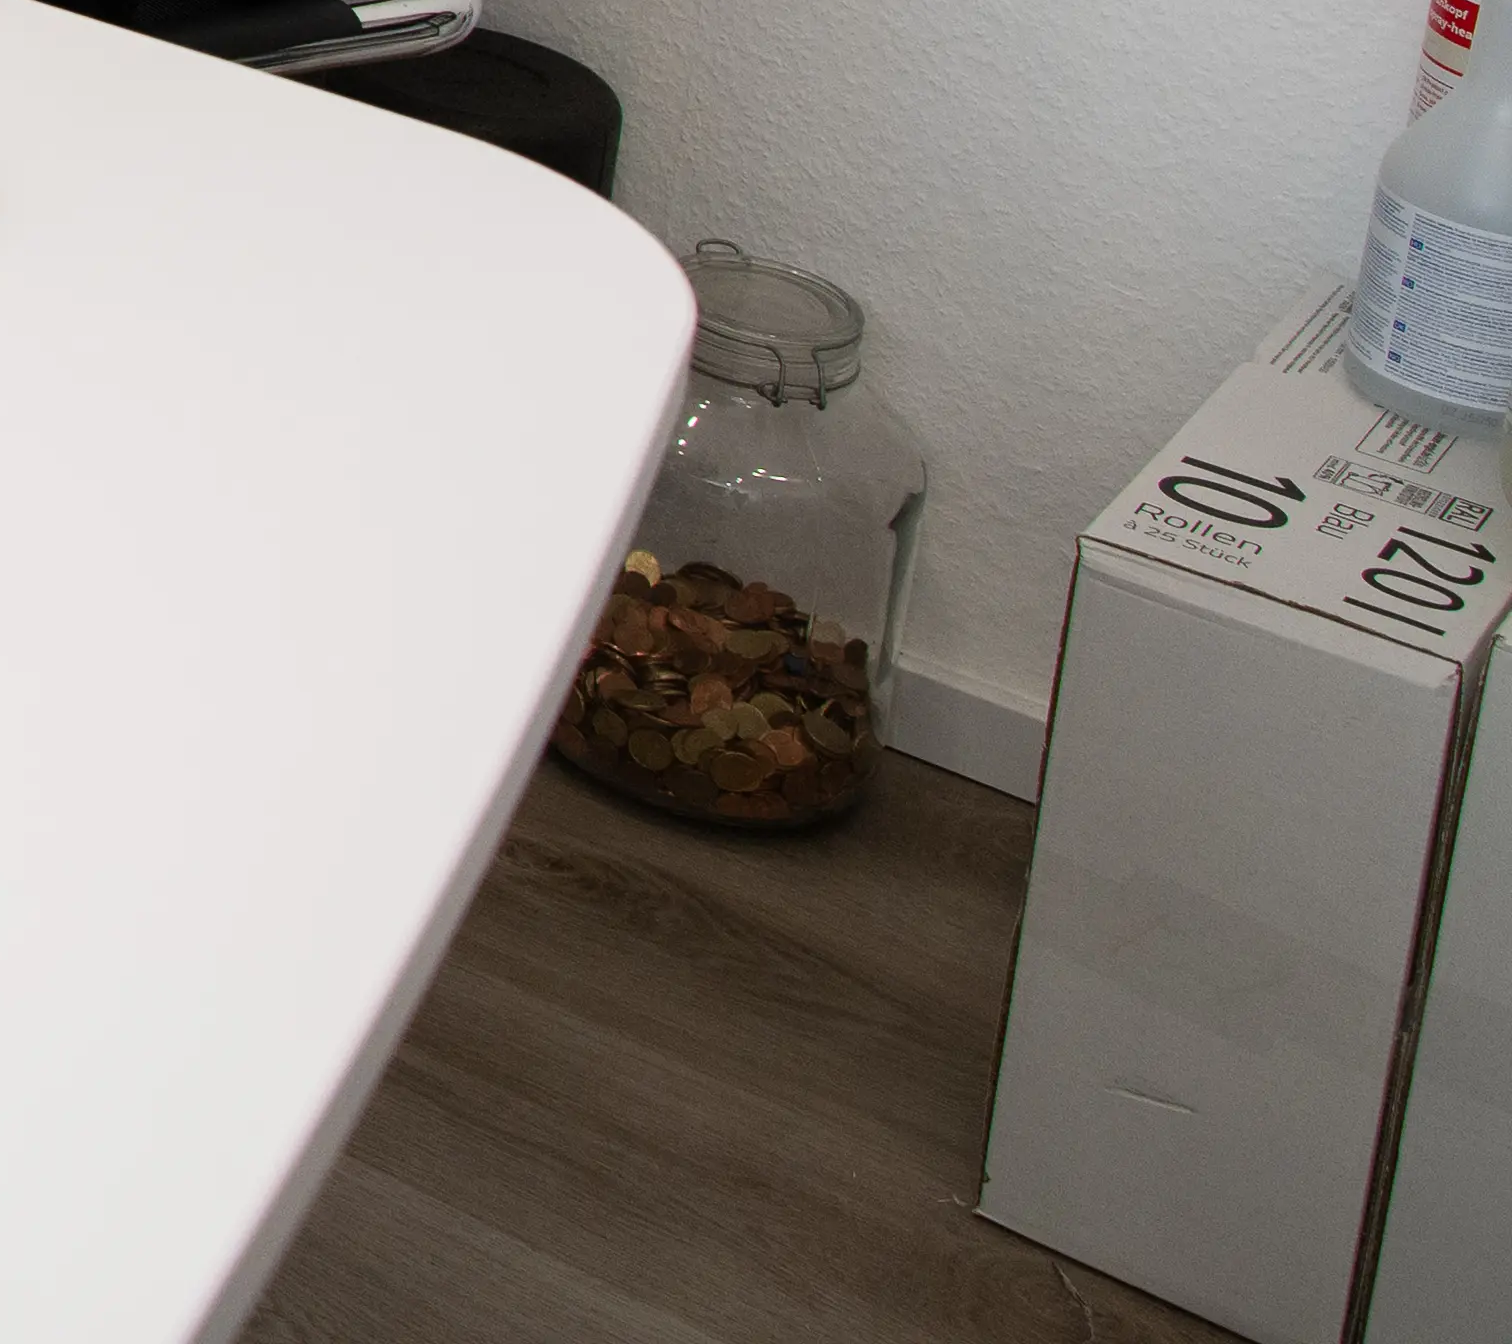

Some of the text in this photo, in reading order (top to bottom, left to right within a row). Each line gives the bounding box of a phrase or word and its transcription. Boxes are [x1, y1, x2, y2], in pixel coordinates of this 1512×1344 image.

[1156, 455, 1307, 530] 10
[1133, 502, 1263, 556] Rollen
[1315, 502, 1376, 541] Blau
[1142, 528, 1176, 545] 25
[1182, 538, 1253, 570] Stück
